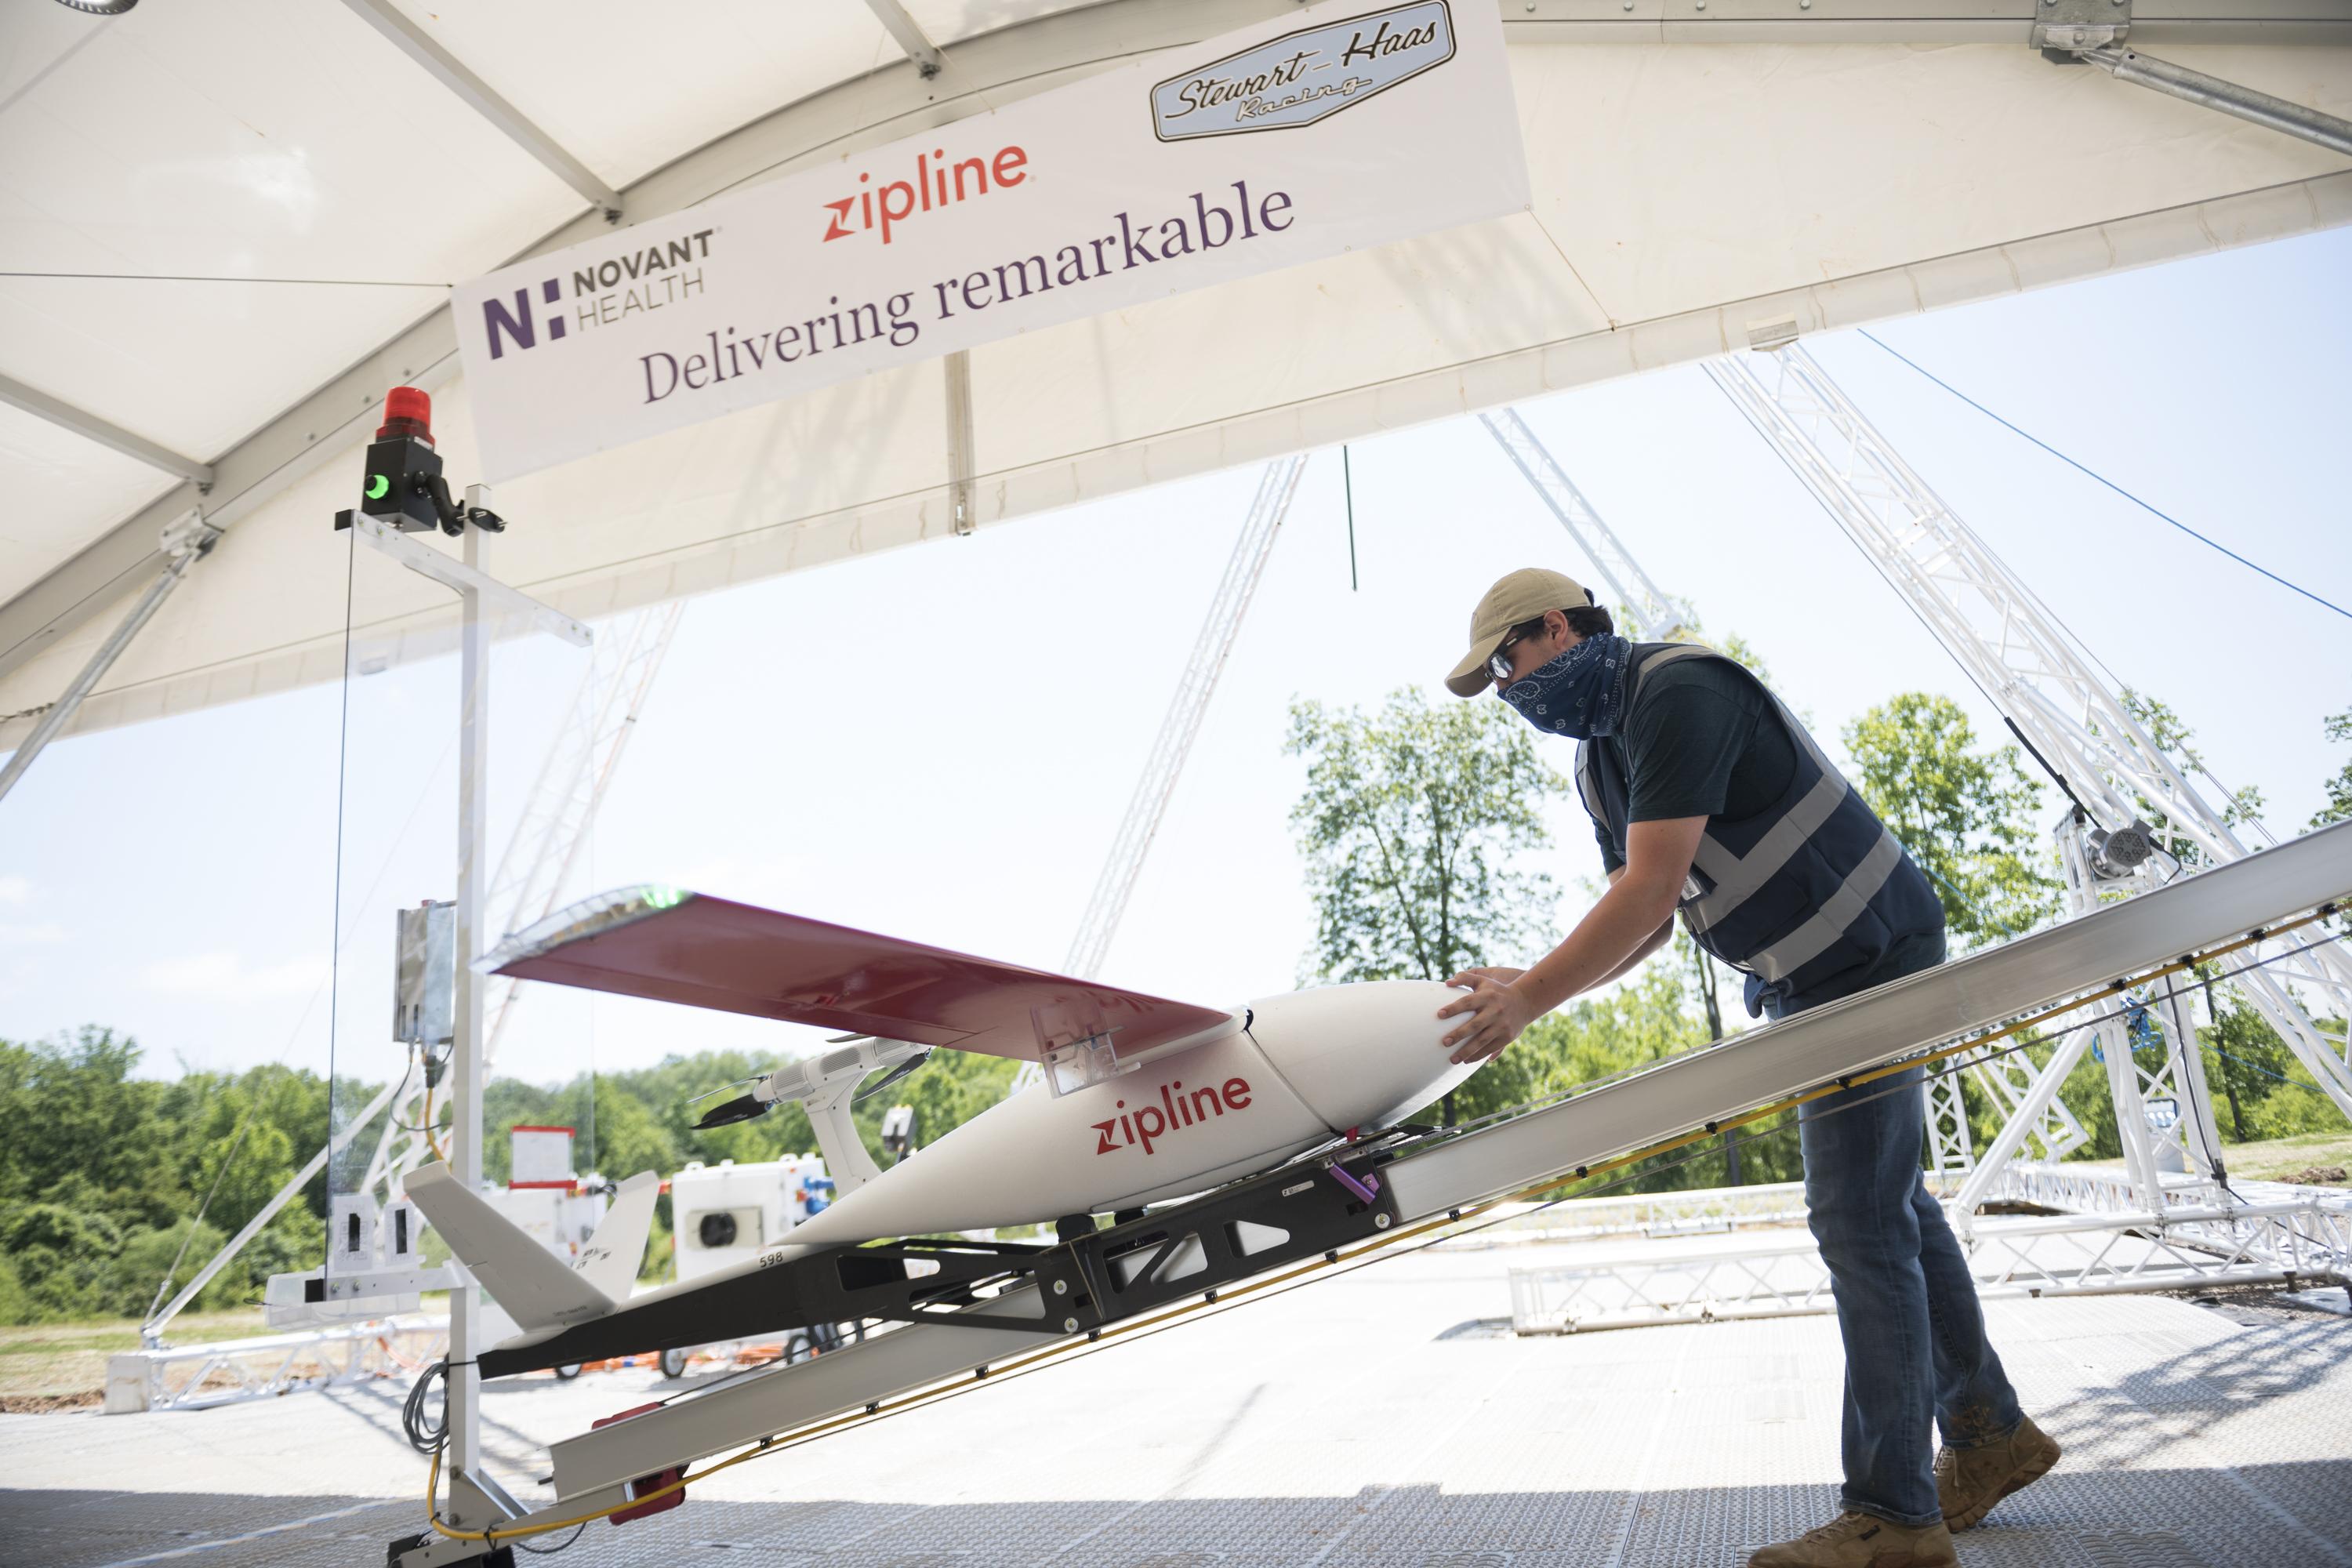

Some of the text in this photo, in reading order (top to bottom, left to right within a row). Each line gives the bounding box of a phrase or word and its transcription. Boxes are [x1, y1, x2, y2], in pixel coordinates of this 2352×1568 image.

[1236, 77, 1372, 122] Racing
[823, 146, 1028, 245] zipline
[572, 228, 714, 298] NOVANT
[639, 180, 1294, 405] Delivering remarkable
[577, 267, 705, 331] HEALTH
[1091, 1077, 1252, 1155] zipline
[760, 1251, 783, 1268] 598
